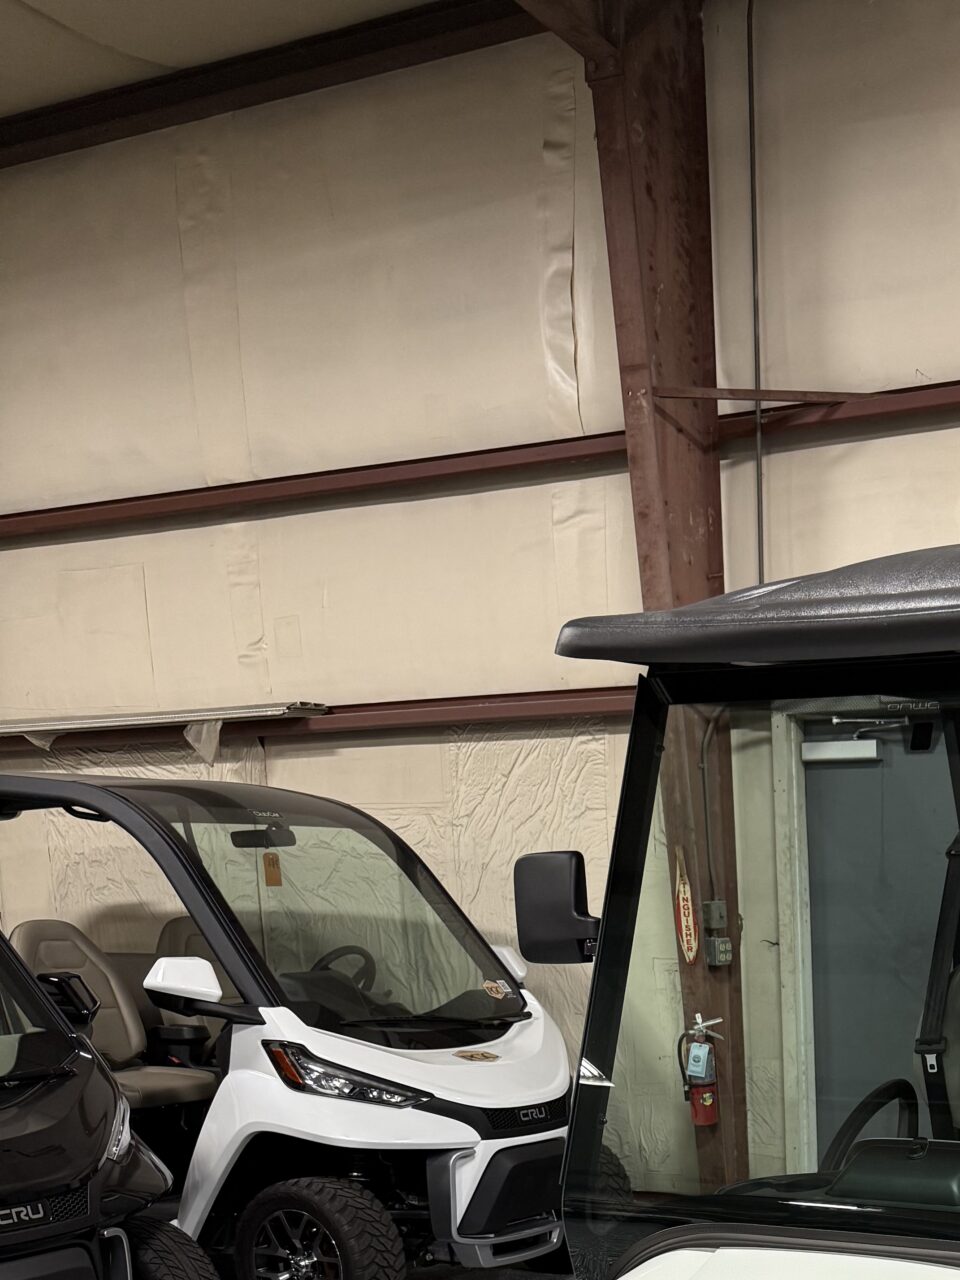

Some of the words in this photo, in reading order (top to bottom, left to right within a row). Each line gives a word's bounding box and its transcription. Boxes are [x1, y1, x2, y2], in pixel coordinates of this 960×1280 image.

[681, 880, 693, 953] TINGUISHER
[519, 1107, 546, 1121] CRU
[0, 1203, 44, 1225] CRU
